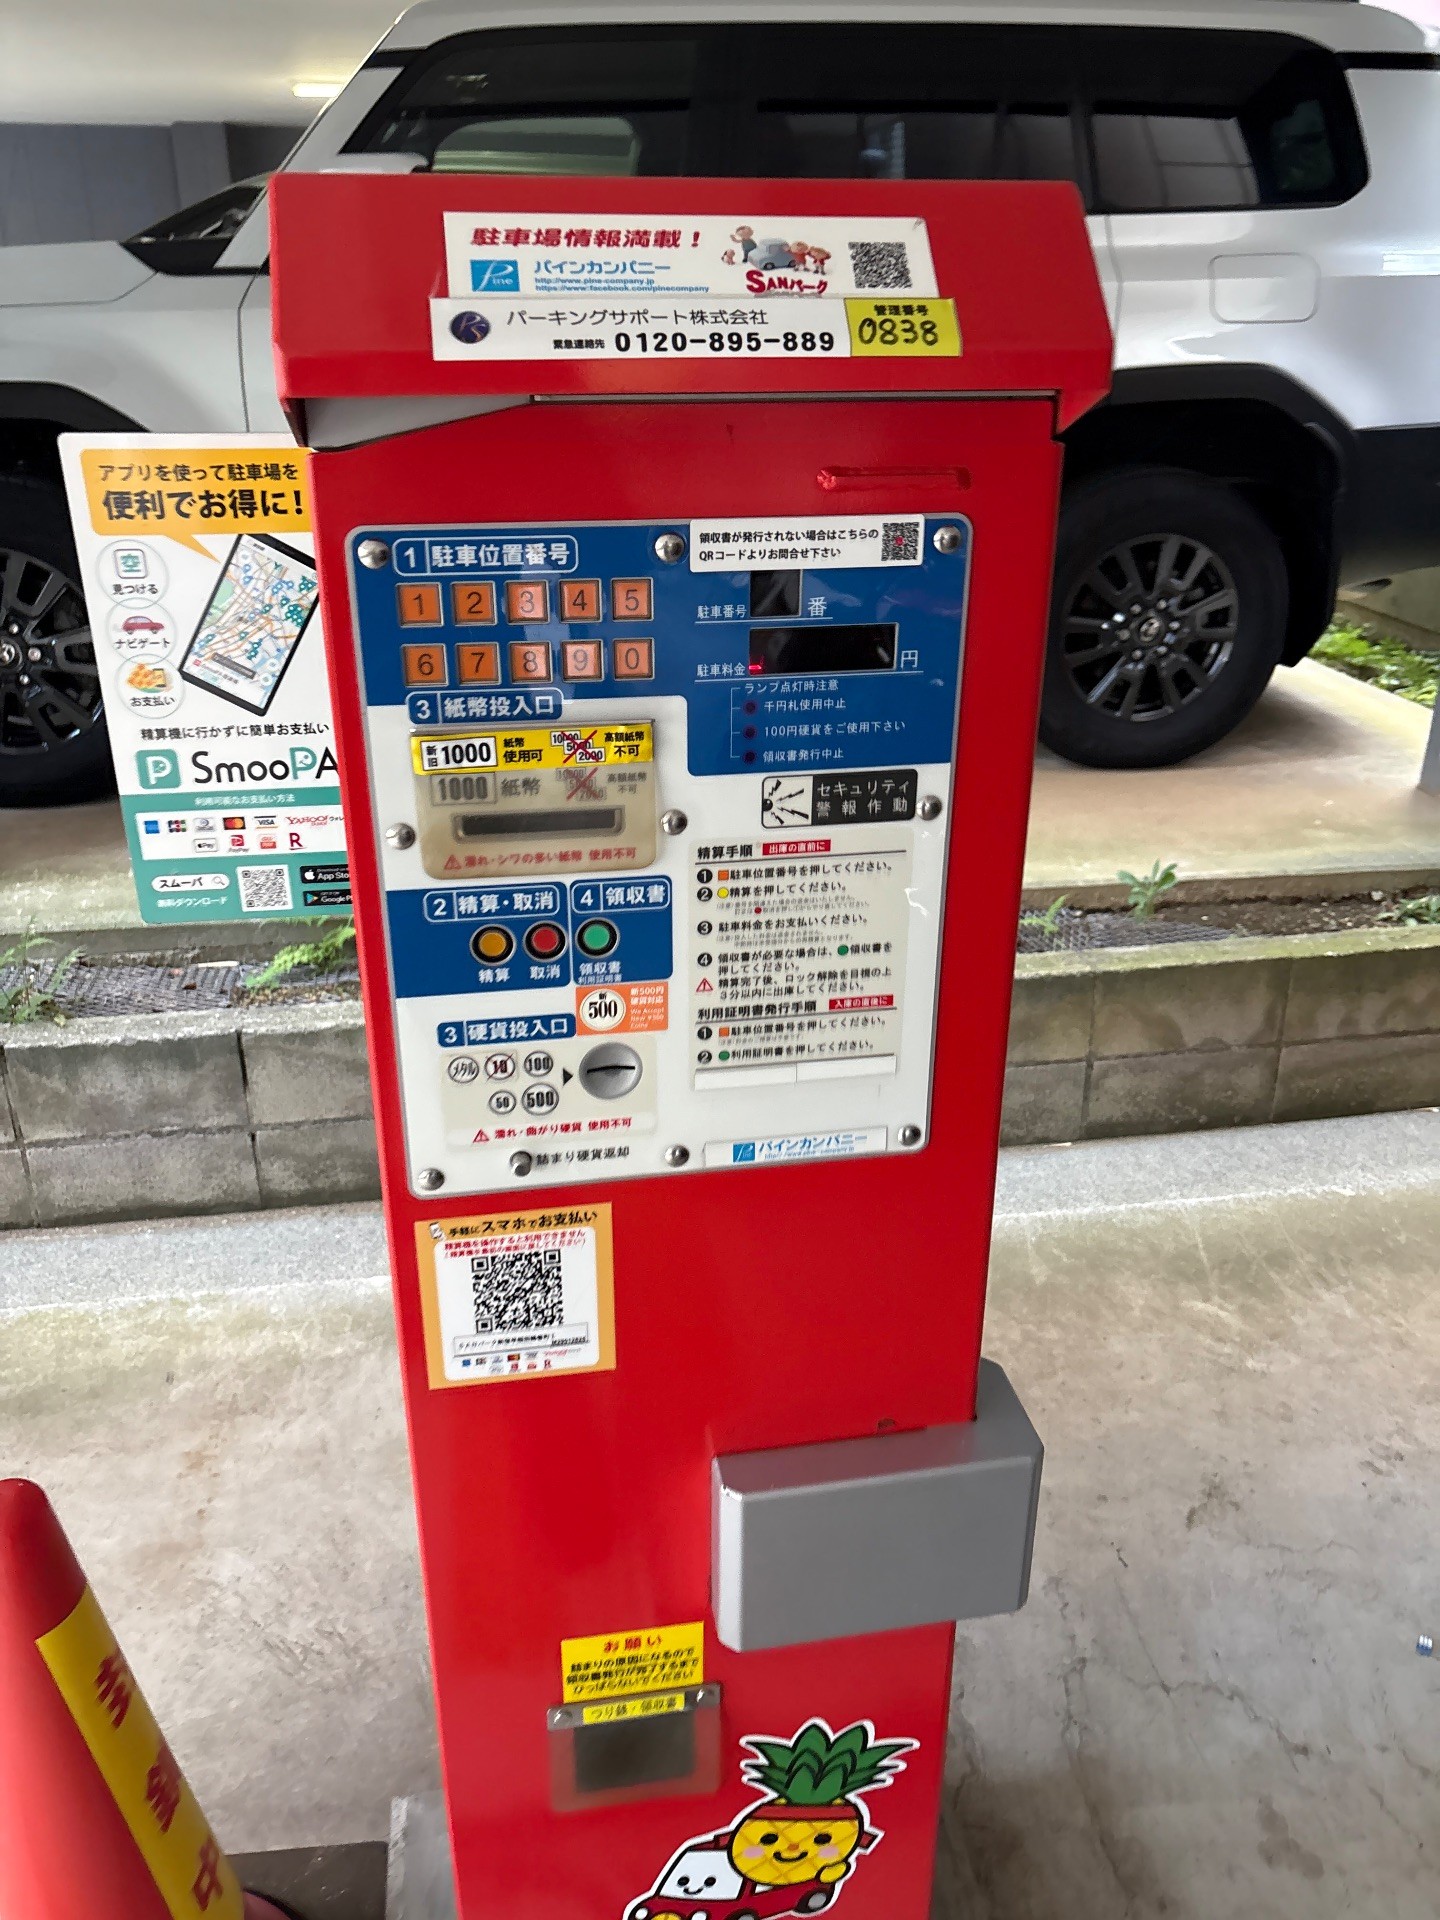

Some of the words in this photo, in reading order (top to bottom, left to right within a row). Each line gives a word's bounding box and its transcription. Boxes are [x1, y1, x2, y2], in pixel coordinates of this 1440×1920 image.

[470, 226, 701, 250] 駐車場情報満載！
[534, 258, 671, 275] パインカンパニー
[506, 307, 769, 327] パーキングサポート株式会社
[873, 303, 930, 316] 管理番号
[857, 318, 940, 347] 0838
[553, 336, 606, 350] 緊急連絡先
[614, 331, 835, 353] 0120-895-889
[97, 464, 299, 483] アプリを使って駐車場を
[699, 528, 879, 546] 領収書が発行されない場合はこちらの
[403, 547, 416, 568] 1
[431, 542, 570, 567] 駐車位置番号
[699, 547, 842, 562] QRコードよりお問合せ下さい
[112, 583, 160, 597] 見つける
[413, 592, 426, 616] 1
[467, 591, 484, 615] 2
[519, 590, 536, 614] 3
[572, 588, 589, 611] 4
[624, 588, 641, 611] 5
[697, 604, 748, 620] 駐車番号
[807, 595, 828, 618] 番
[115, 638, 171, 650] ナビゲート
[418, 653, 435, 676] 6
[472, 651, 487, 674] 7
[523, 650, 540, 673] 8
[573, 649, 590, 671] 9
[624, 647, 641, 670] 0
[697, 662, 746, 677] 駐車料金
[900, 649, 919, 668] 円
[744, 679, 840, 694] ランプ点灯時注意
[129, 696, 176, 708] お支払い
[415, 699, 431, 721] 3
[444, 694, 555, 720] 紙幣投入口
[763, 698, 847, 713] 千円札使用中止
[140, 723, 330, 742] 精算機に行かずに簡単お支払い
[604, 731, 646, 744] 高額紙幣
[764, 720, 906, 738] 100円硬貨をご使用下さい
[503, 737, 526, 749] 紙幣
[613, 743, 640, 757] 不可
[440, 741, 492, 765] 1000
[503, 749, 543, 764] 使用可
[762, 749, 845, 764] 領収書発行中止
[607, 771, 649, 785] 高額紙幣
[438, 776, 490, 803] 1000
[500, 778, 542, 798] 紙幣
[616, 783, 638, 796] 不可
[816, 778, 910, 798] セキュリティ
[194, 793, 296, 807] 利用可能なお支払い方法
[816, 796, 908, 819] 警報作動
[588, 846, 637, 862] 使用不可
[696, 843, 755, 861] 精算手順
[768, 840, 827, 855] 出庫の直前に
[157, 895, 228, 909] 無料ダウンロード
[320, 895, 345, 904] Google
[432, 898, 447, 916] 2
[457, 891, 554, 915] 精算・取消
[579, 889, 593, 906] 4
[605, 884, 667, 906] 領収書
[850, 941, 893, 956] 領収書を
[478, 967, 511, 983] 精算
[529, 965, 561, 979] 取消
[578, 961, 622, 975] 領収書
[630, 985, 665, 996] 新500円
[588, 1000, 619, 1019] 500
[697, 1000, 818, 1021] 利用証明書発行手順
[443, 1025, 458, 1044] 3
[467, 1017, 570, 1042] 硬貨投入口
[526, 1056, 551, 1072] 100
[495, 1096, 511, 1109] 50
[525, 1090, 556, 1109] 500
[588, 1116, 633, 1132] 使用不可
[758, 1134, 868, 1154] パインカンパニー
[535, 1145, 631, 1167] 詰まり硬貨返却
[448, 1209, 599, 1239] 手軽にスマホでお支払い
[604, 1636, 661, 1653] お願い
